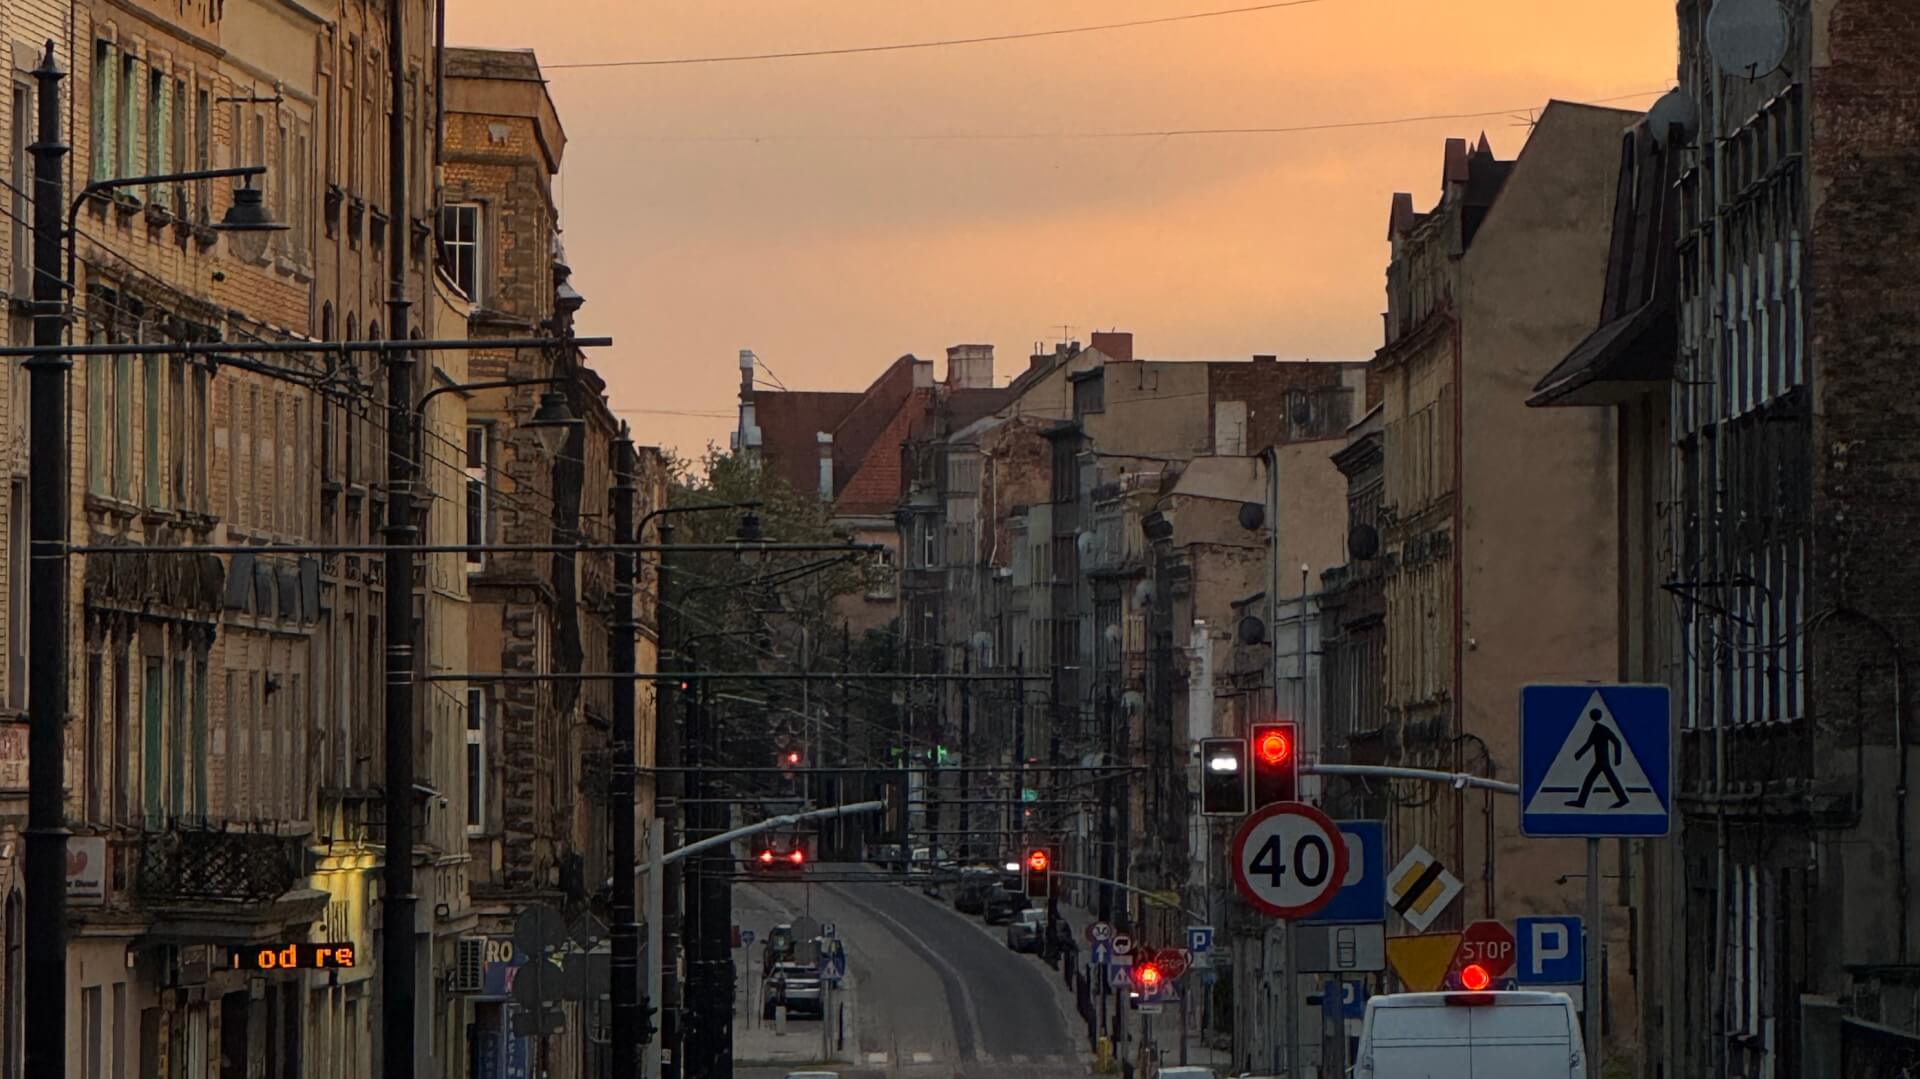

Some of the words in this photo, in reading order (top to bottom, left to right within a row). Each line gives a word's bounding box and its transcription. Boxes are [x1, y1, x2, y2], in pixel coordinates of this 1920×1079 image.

[1249, 835, 1329, 888] 40
[1194, 932, 1206, 949] P
[1463, 940, 1512, 960] STOP
[1531, 922, 1568, 974] P
[258, 943, 297, 969] od
